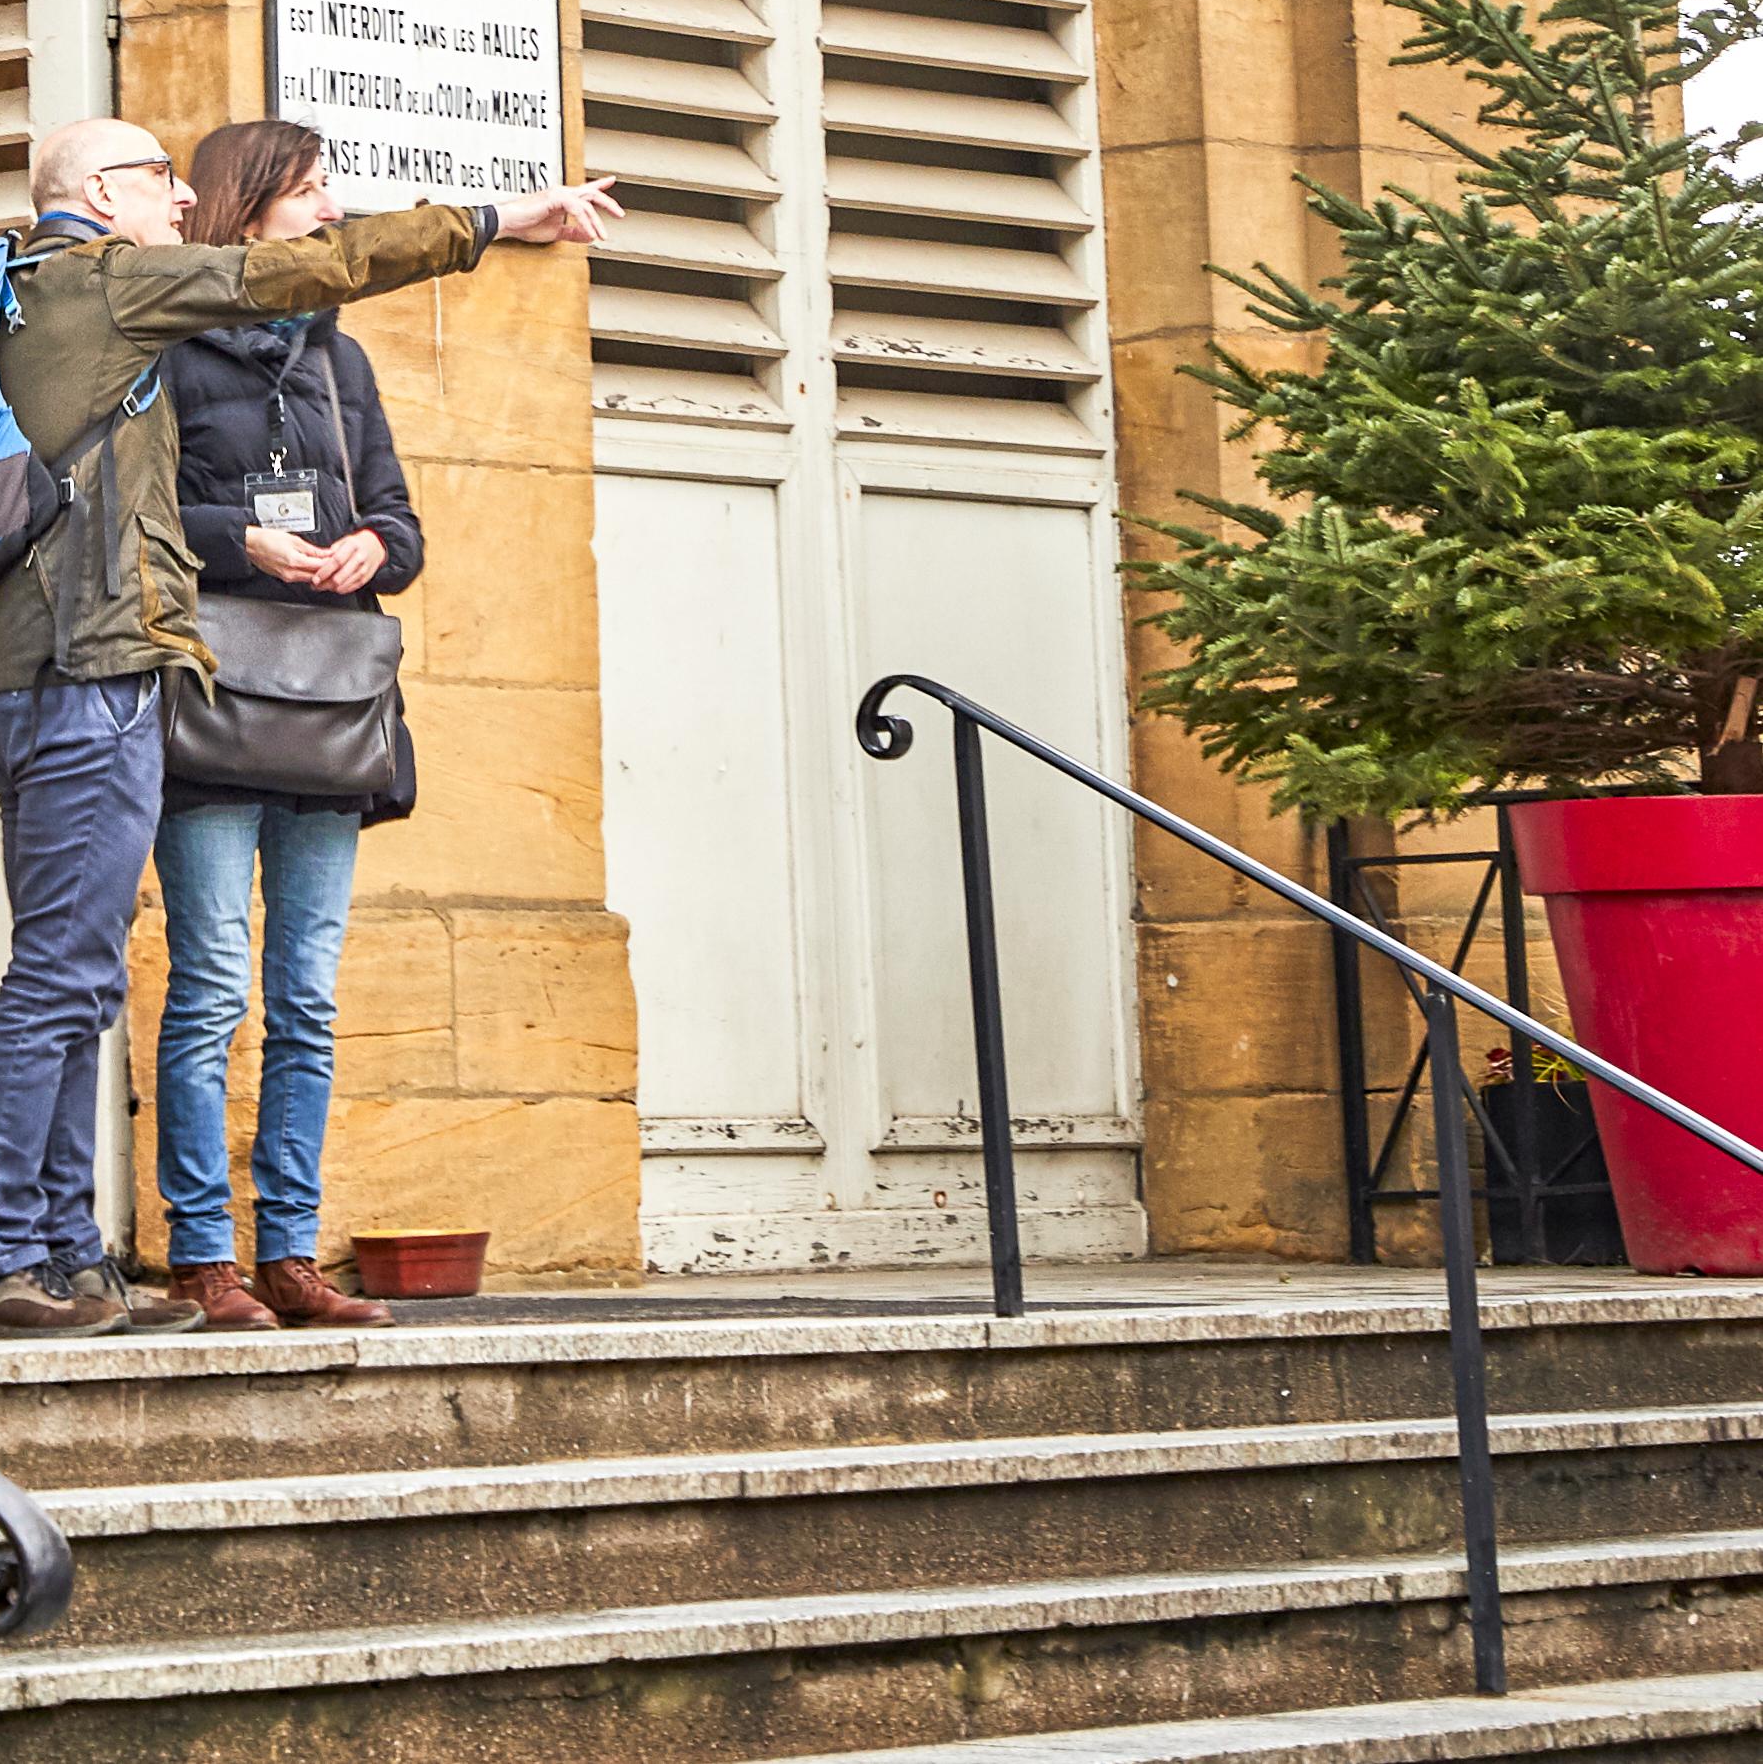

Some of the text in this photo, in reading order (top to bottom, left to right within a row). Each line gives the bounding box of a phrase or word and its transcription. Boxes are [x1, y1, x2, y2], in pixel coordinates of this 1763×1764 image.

[290, 0, 540, 61] EST INTERDITE DANS LES HALLES
[407, 90, 419, 115] DE
[422, 91, 433, 116] LA
[436, 81, 473, 121] COUR
[476, 98, 489, 123] DU
[320, 138, 548, 194] ENSE D'AMENER DES CHIENS
